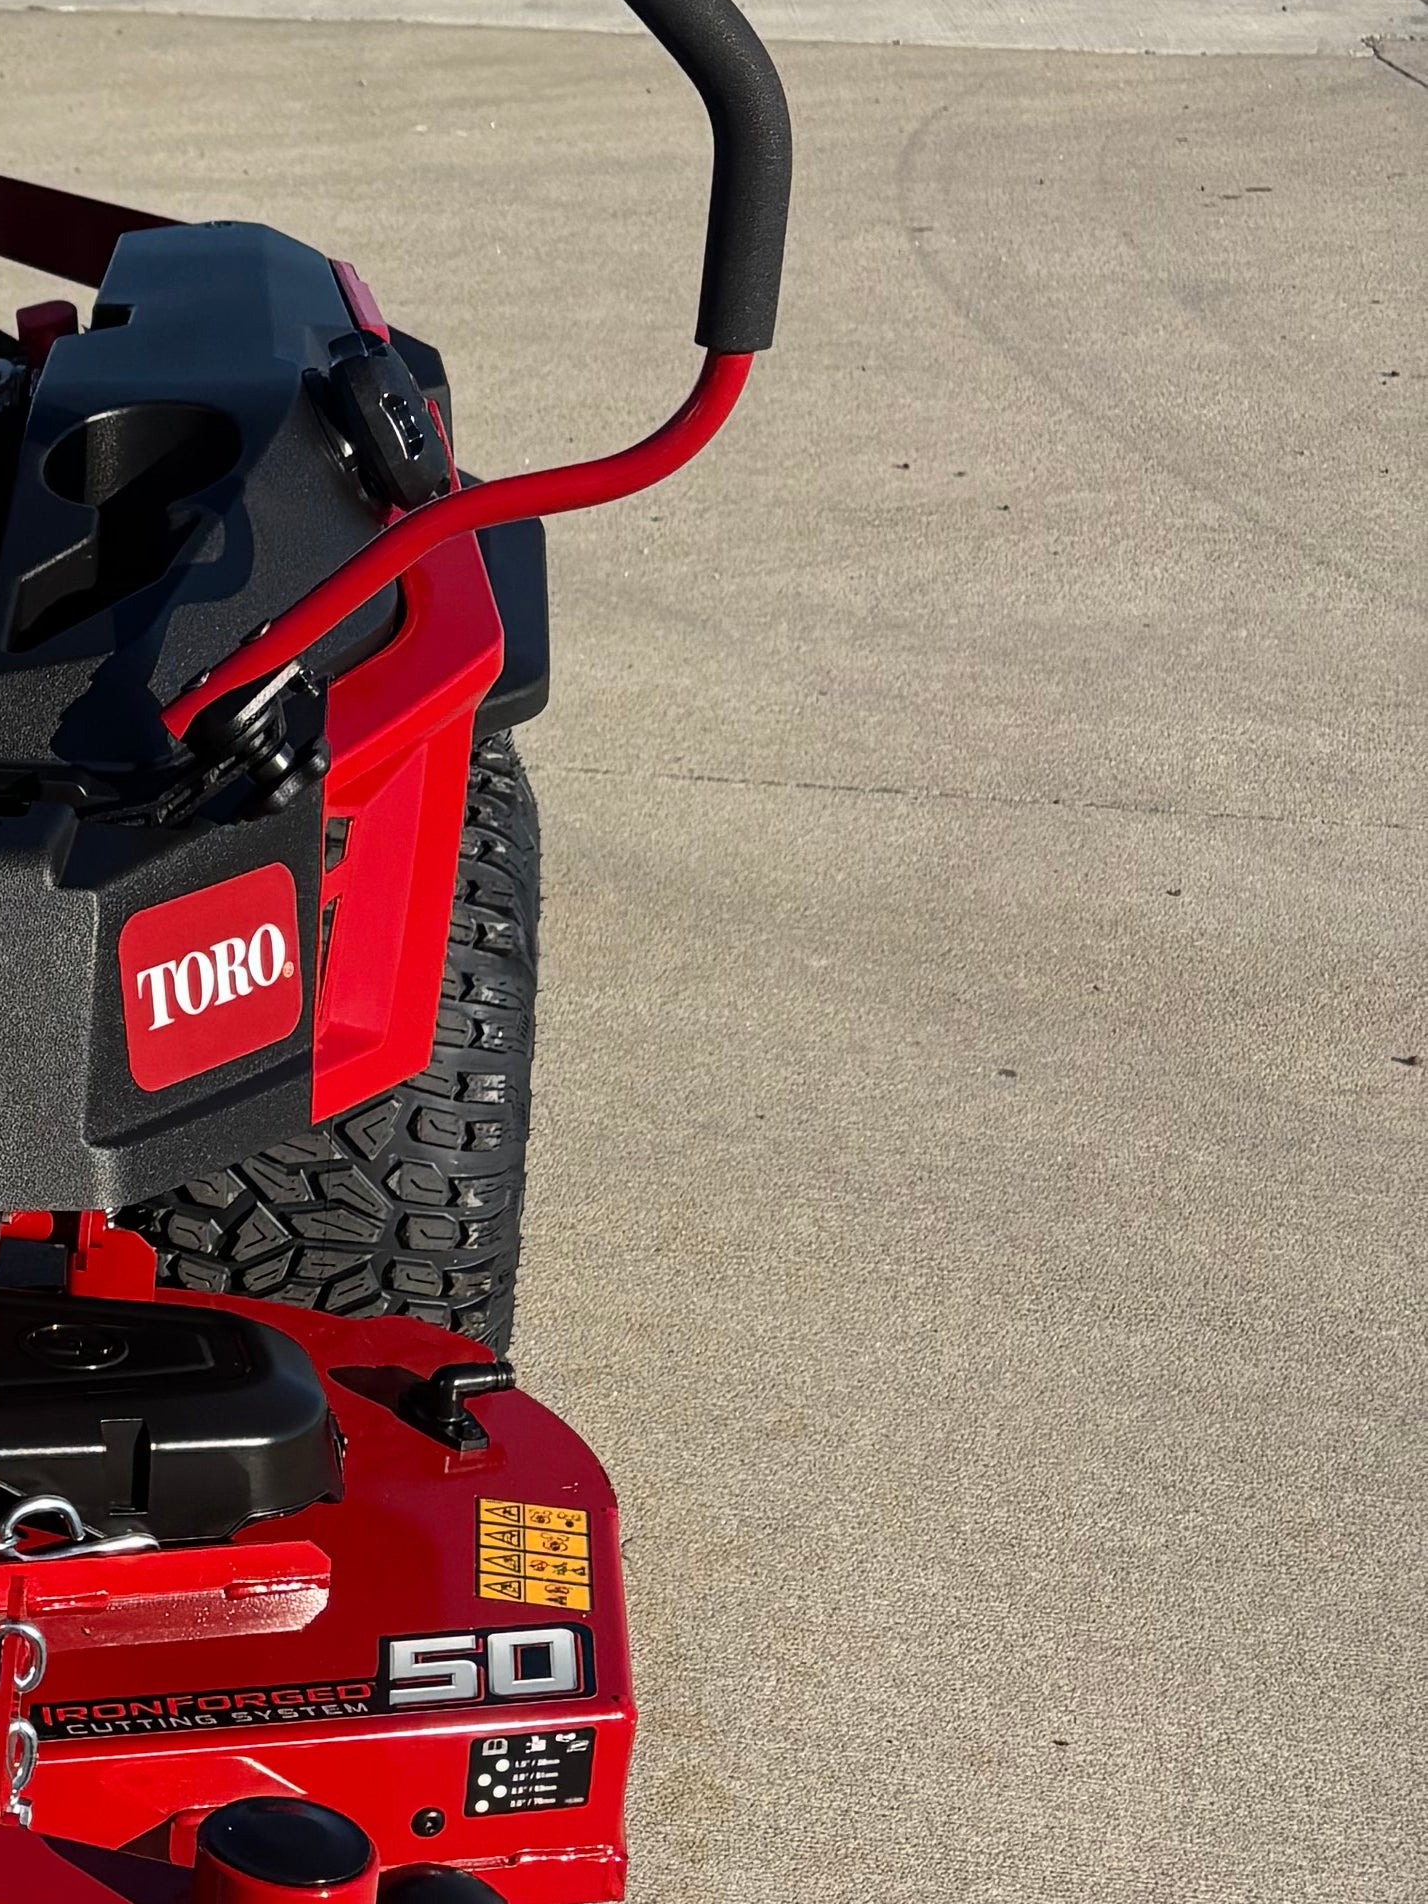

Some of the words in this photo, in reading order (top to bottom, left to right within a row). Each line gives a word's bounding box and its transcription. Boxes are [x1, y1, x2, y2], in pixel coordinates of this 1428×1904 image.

[136, 923, 286, 1030] TORO
[389, 1628, 584, 1707] 50
[66, 1714, 217, 1735] CUTTING
[231, 1702, 370, 1723] SYSTEM
